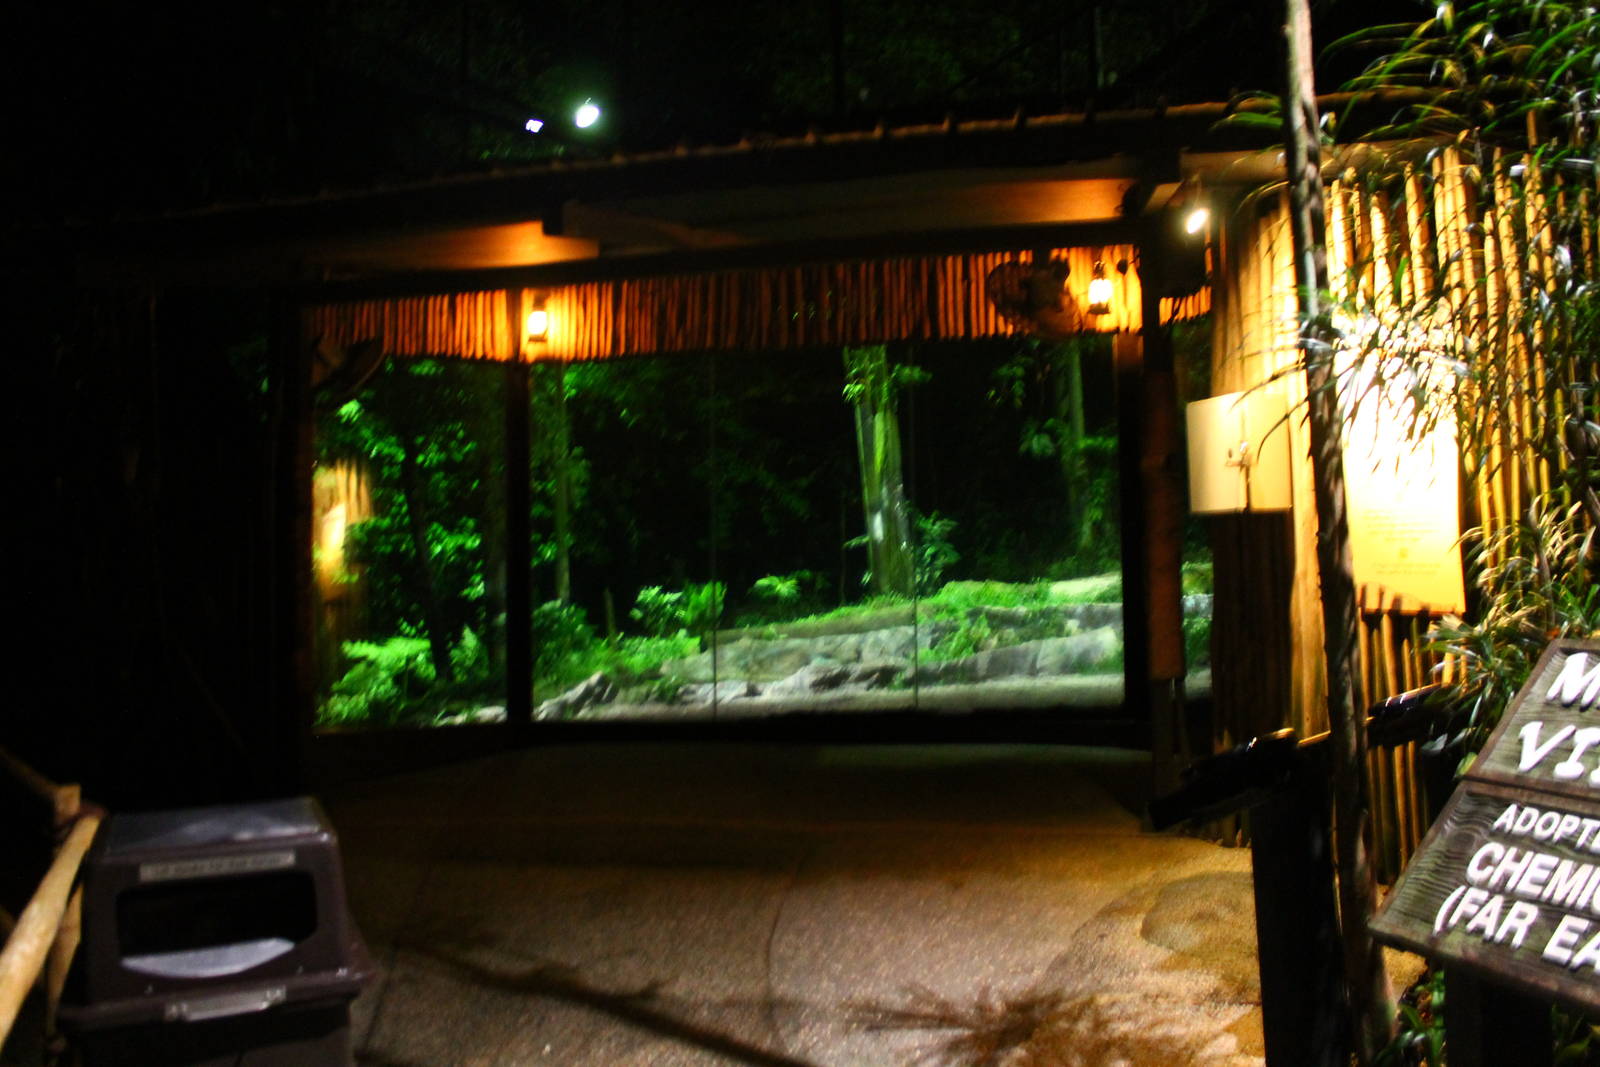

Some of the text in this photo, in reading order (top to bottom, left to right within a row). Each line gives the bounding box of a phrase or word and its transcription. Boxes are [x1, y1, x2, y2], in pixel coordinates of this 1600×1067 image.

[1545, 651, 1600, 709] M
[1518, 721, 1600, 787] VI
[1432, 884, 1539, 948] (FAR
